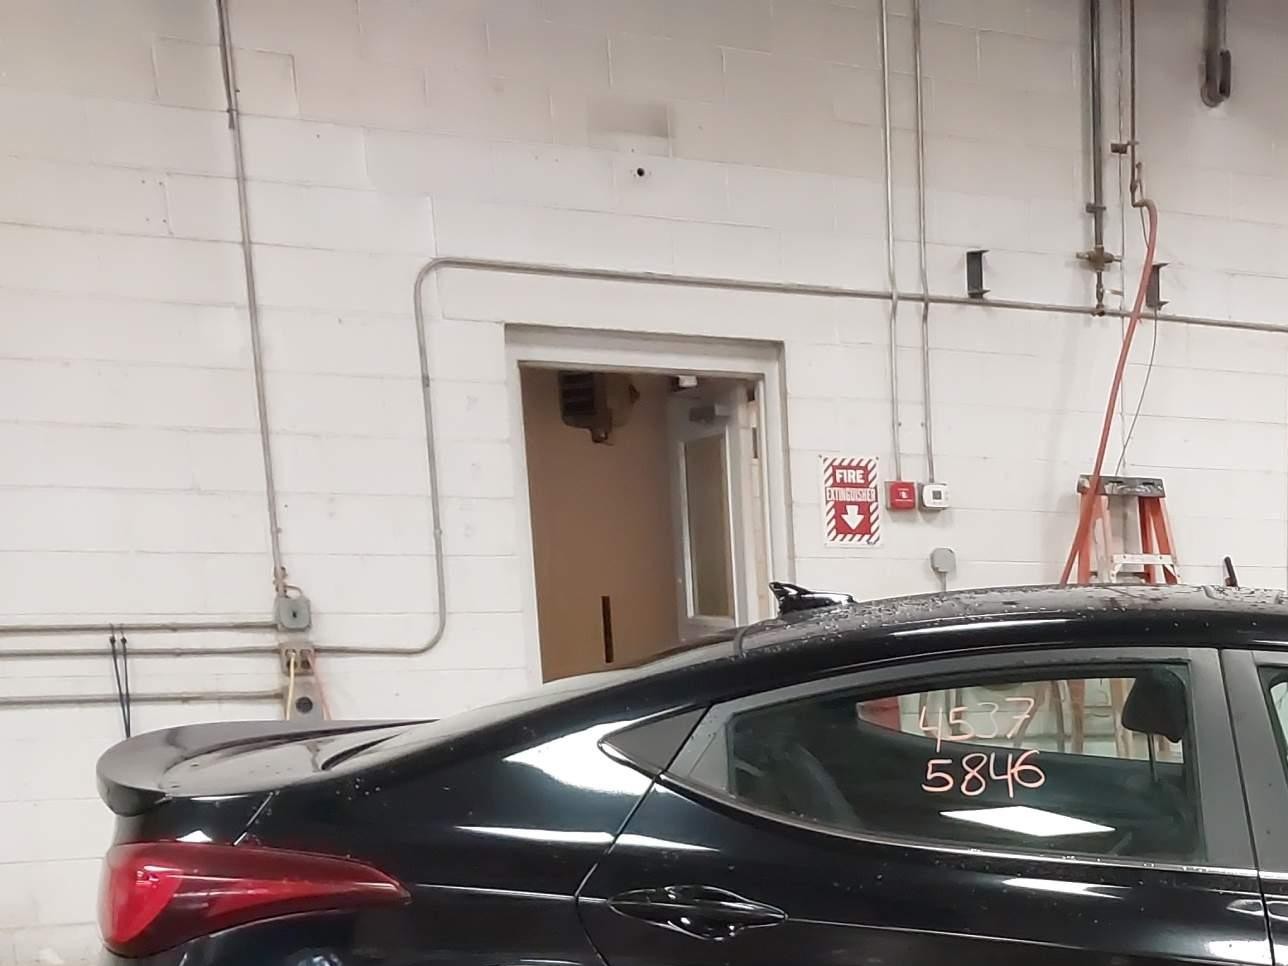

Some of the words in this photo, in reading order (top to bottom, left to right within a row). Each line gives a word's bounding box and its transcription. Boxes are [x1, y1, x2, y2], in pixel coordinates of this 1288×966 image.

[835, 469, 865, 484] FIRE
[826, 487, 876, 502] EXTINGUISHER
[918, 697, 1035, 753] 4537
[921, 750, 1046, 798] 5846
